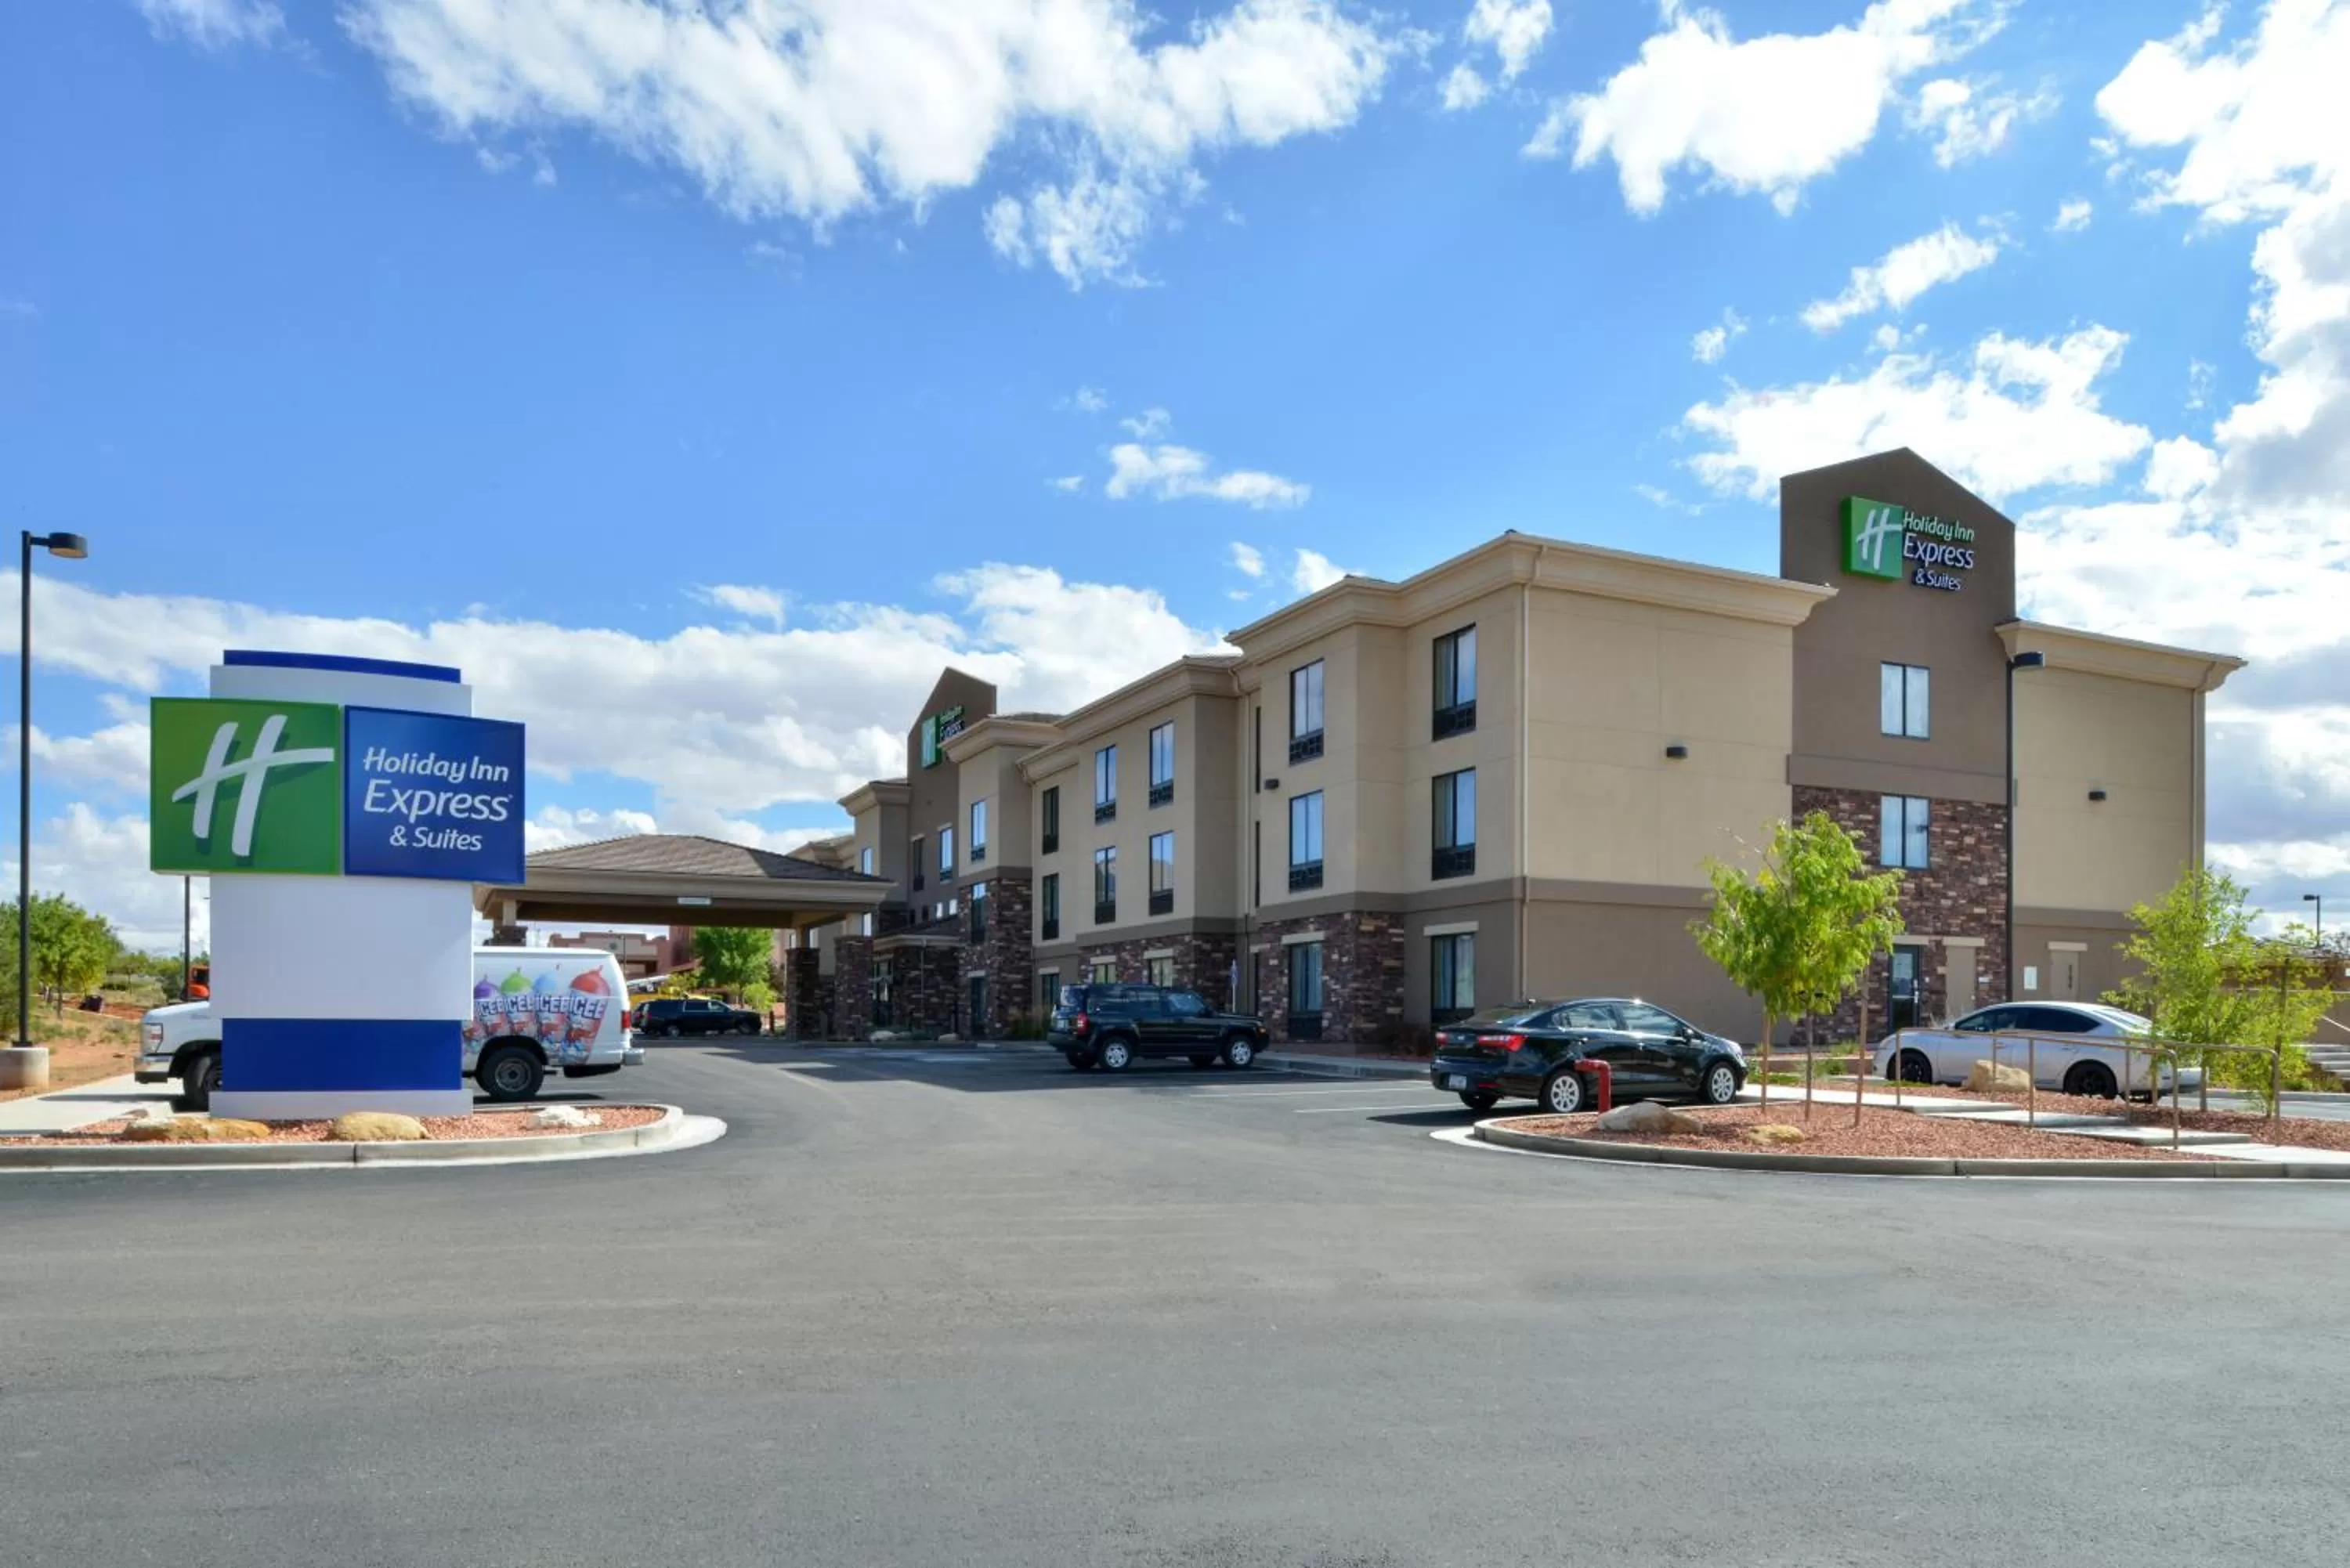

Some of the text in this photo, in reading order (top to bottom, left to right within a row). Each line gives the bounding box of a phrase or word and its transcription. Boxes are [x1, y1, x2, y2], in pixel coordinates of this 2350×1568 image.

[1903, 511, 1975, 542] Holiday Inn
[1904, 533, 1975, 569] Express
[1915, 568, 1961, 591] & Suites
[363, 746, 509, 784] Holiday Inn
[172, 714, 334, 857] H
[363, 778, 511, 824] Express
[389, 825, 483, 851] & Suites
[569, 996, 606, 1020] ICEE
